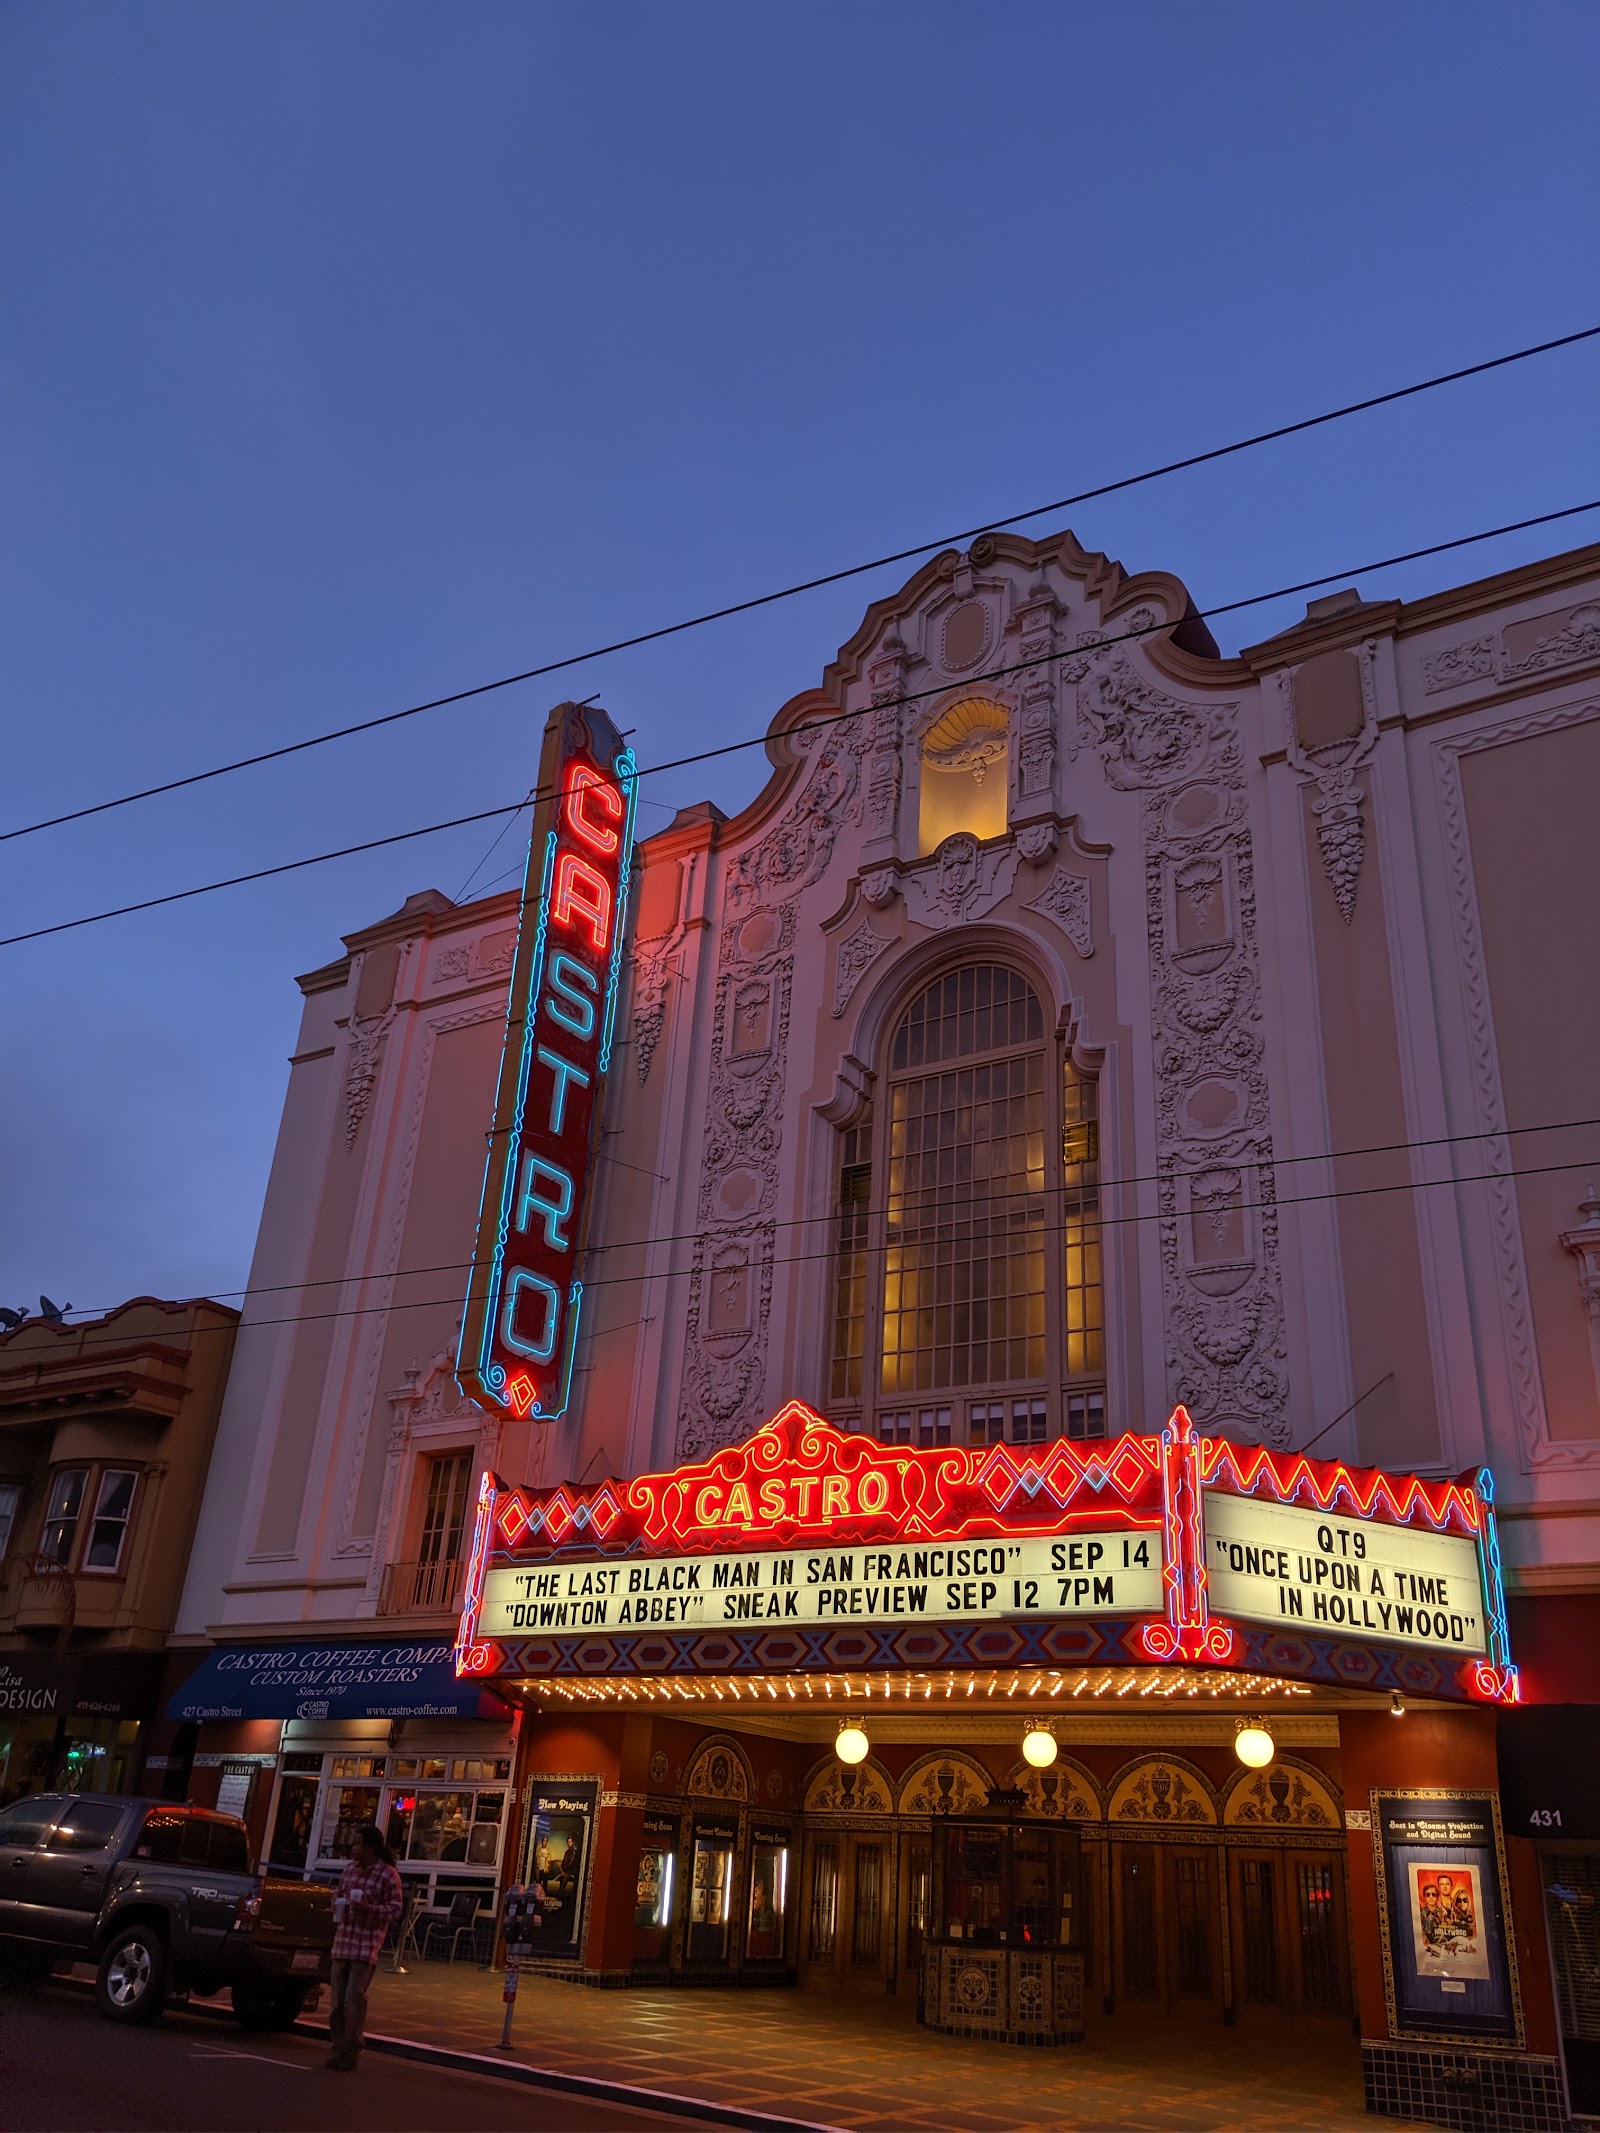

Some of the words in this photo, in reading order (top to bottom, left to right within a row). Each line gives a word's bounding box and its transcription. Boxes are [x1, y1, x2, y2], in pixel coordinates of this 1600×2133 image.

[500, 763, 622, 1367] CASTRO
[695, 1471, 889, 1524] CASTRO
[1317, 1525, 1366, 1559] QT9
[515, 1574, 560, 1598] "THE
[568, 1570, 620, 1597] LAST
[629, 1564, 701, 1593] BLACK
[712, 1561, 759, 1588] MAN
[772, 1559, 794, 1585] IN
[807, 1555, 853, 1583] SAN
[864, 1547, 1021, 1581] FRANCISCO"
[1051, 1542, 1104, 1571] SEP
[1123, 1540, 1149, 1568] 14
[1216, 1540, 1290, 1579] "ONCE
[1298, 1555, 1361, 1592] UPON
[1370, 1569, 1385, 1597] A
[1395, 1572, 1449, 1606] TIME
[506, 1600, 606, 1627] "DOWNTON
[619, 1596, 704, 1624] ABBEY"
[723, 1591, 799, 1619] SNEAK
[818, 1585, 927, 1616] PREVIEW
[946, 1582, 997, 1611] SEP
[1013, 1580, 1039, 1608] 12
[1057, 1576, 1114, 1606] 7PM
[1279, 1586, 1303, 1616] IN
[1314, 1592, 1475, 1642] HOLLYWOOD"
[217, 1651, 297, 1670] CASTRO
[299, 1649, 380, 1668] COFFEE
[250, 1670, 323, 1686] CUSTOM
[324, 1667, 423, 1684] ROASTERS
[296, 1686, 323, 1697] Since
[324, 1686, 347, 1695] 1970
[182, 1706, 196, 1717] 427
[197, 1706, 220, 1717] Castro
[221, 1706, 242, 1717] Street
[366, 1704, 458, 1715] www.castro-coffee.com
[538, 1798, 557, 1810] Now
[559, 1798, 589, 1812] Playing
[1389, 1820, 1406, 1829] Best
[1408, 1821, 1415, 1829] in
[1417, 1821, 1446, 1830] Cinema
[1447, 1822, 1484, 1831] Projection
[1530, 1810, 1562, 1827] 431
[1406, 1831, 1419, 1839] and
[1421, 1830, 1447, 1840] Digital
[1449, 1831, 1471, 1839] Sound
[191, 1886, 218, 1899] TRD
[1434, 1928, 1467, 1936] HOLLYWOOD
